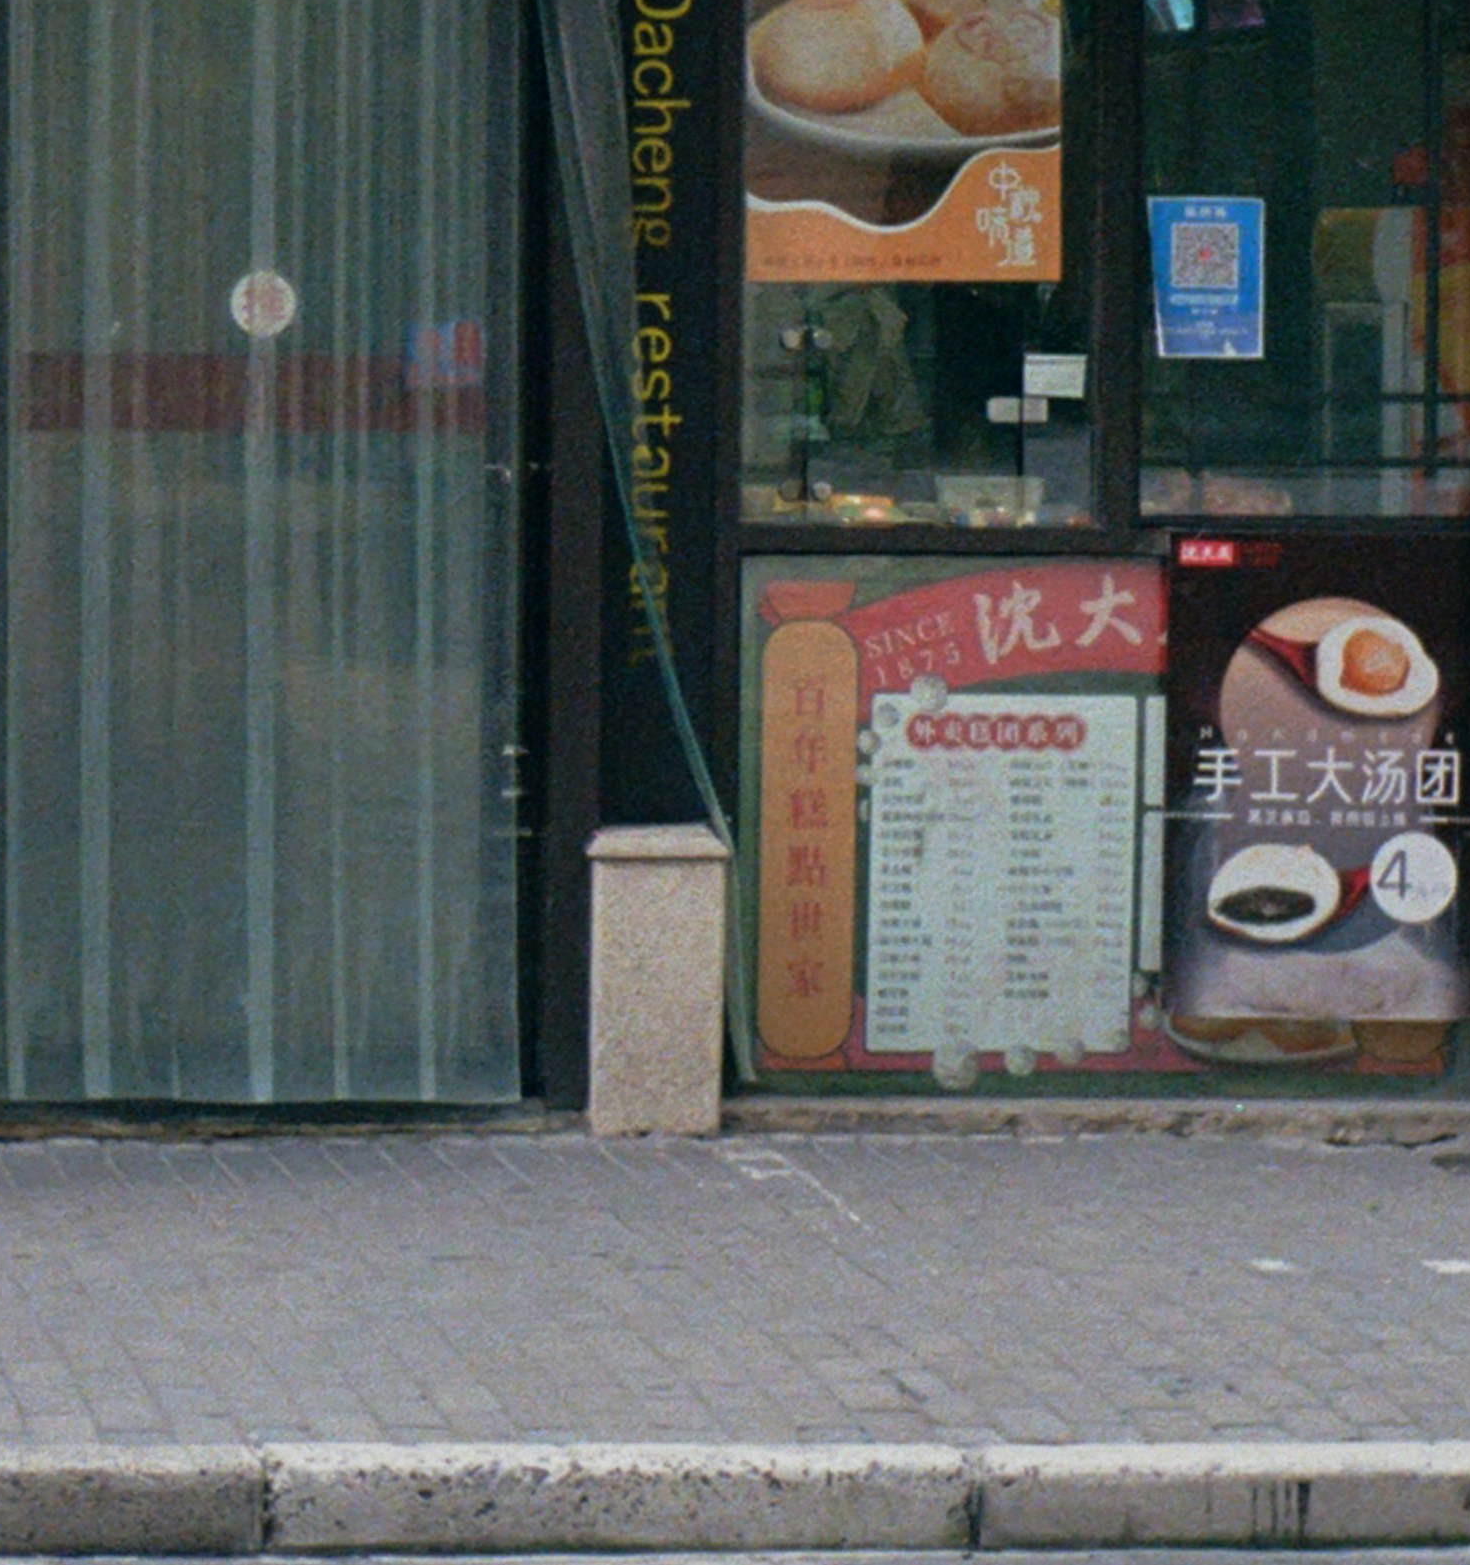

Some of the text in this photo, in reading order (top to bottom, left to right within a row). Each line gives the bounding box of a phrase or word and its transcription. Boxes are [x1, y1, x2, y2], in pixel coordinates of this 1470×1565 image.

[864, 610, 956, 659] SINCE
[972, 572, 1167, 666] 沈大
[874, 641, 962, 687] 1875
[1193, 747, 1459, 805] 手工大汤团
[1376, 848, 1412, 900] 4
